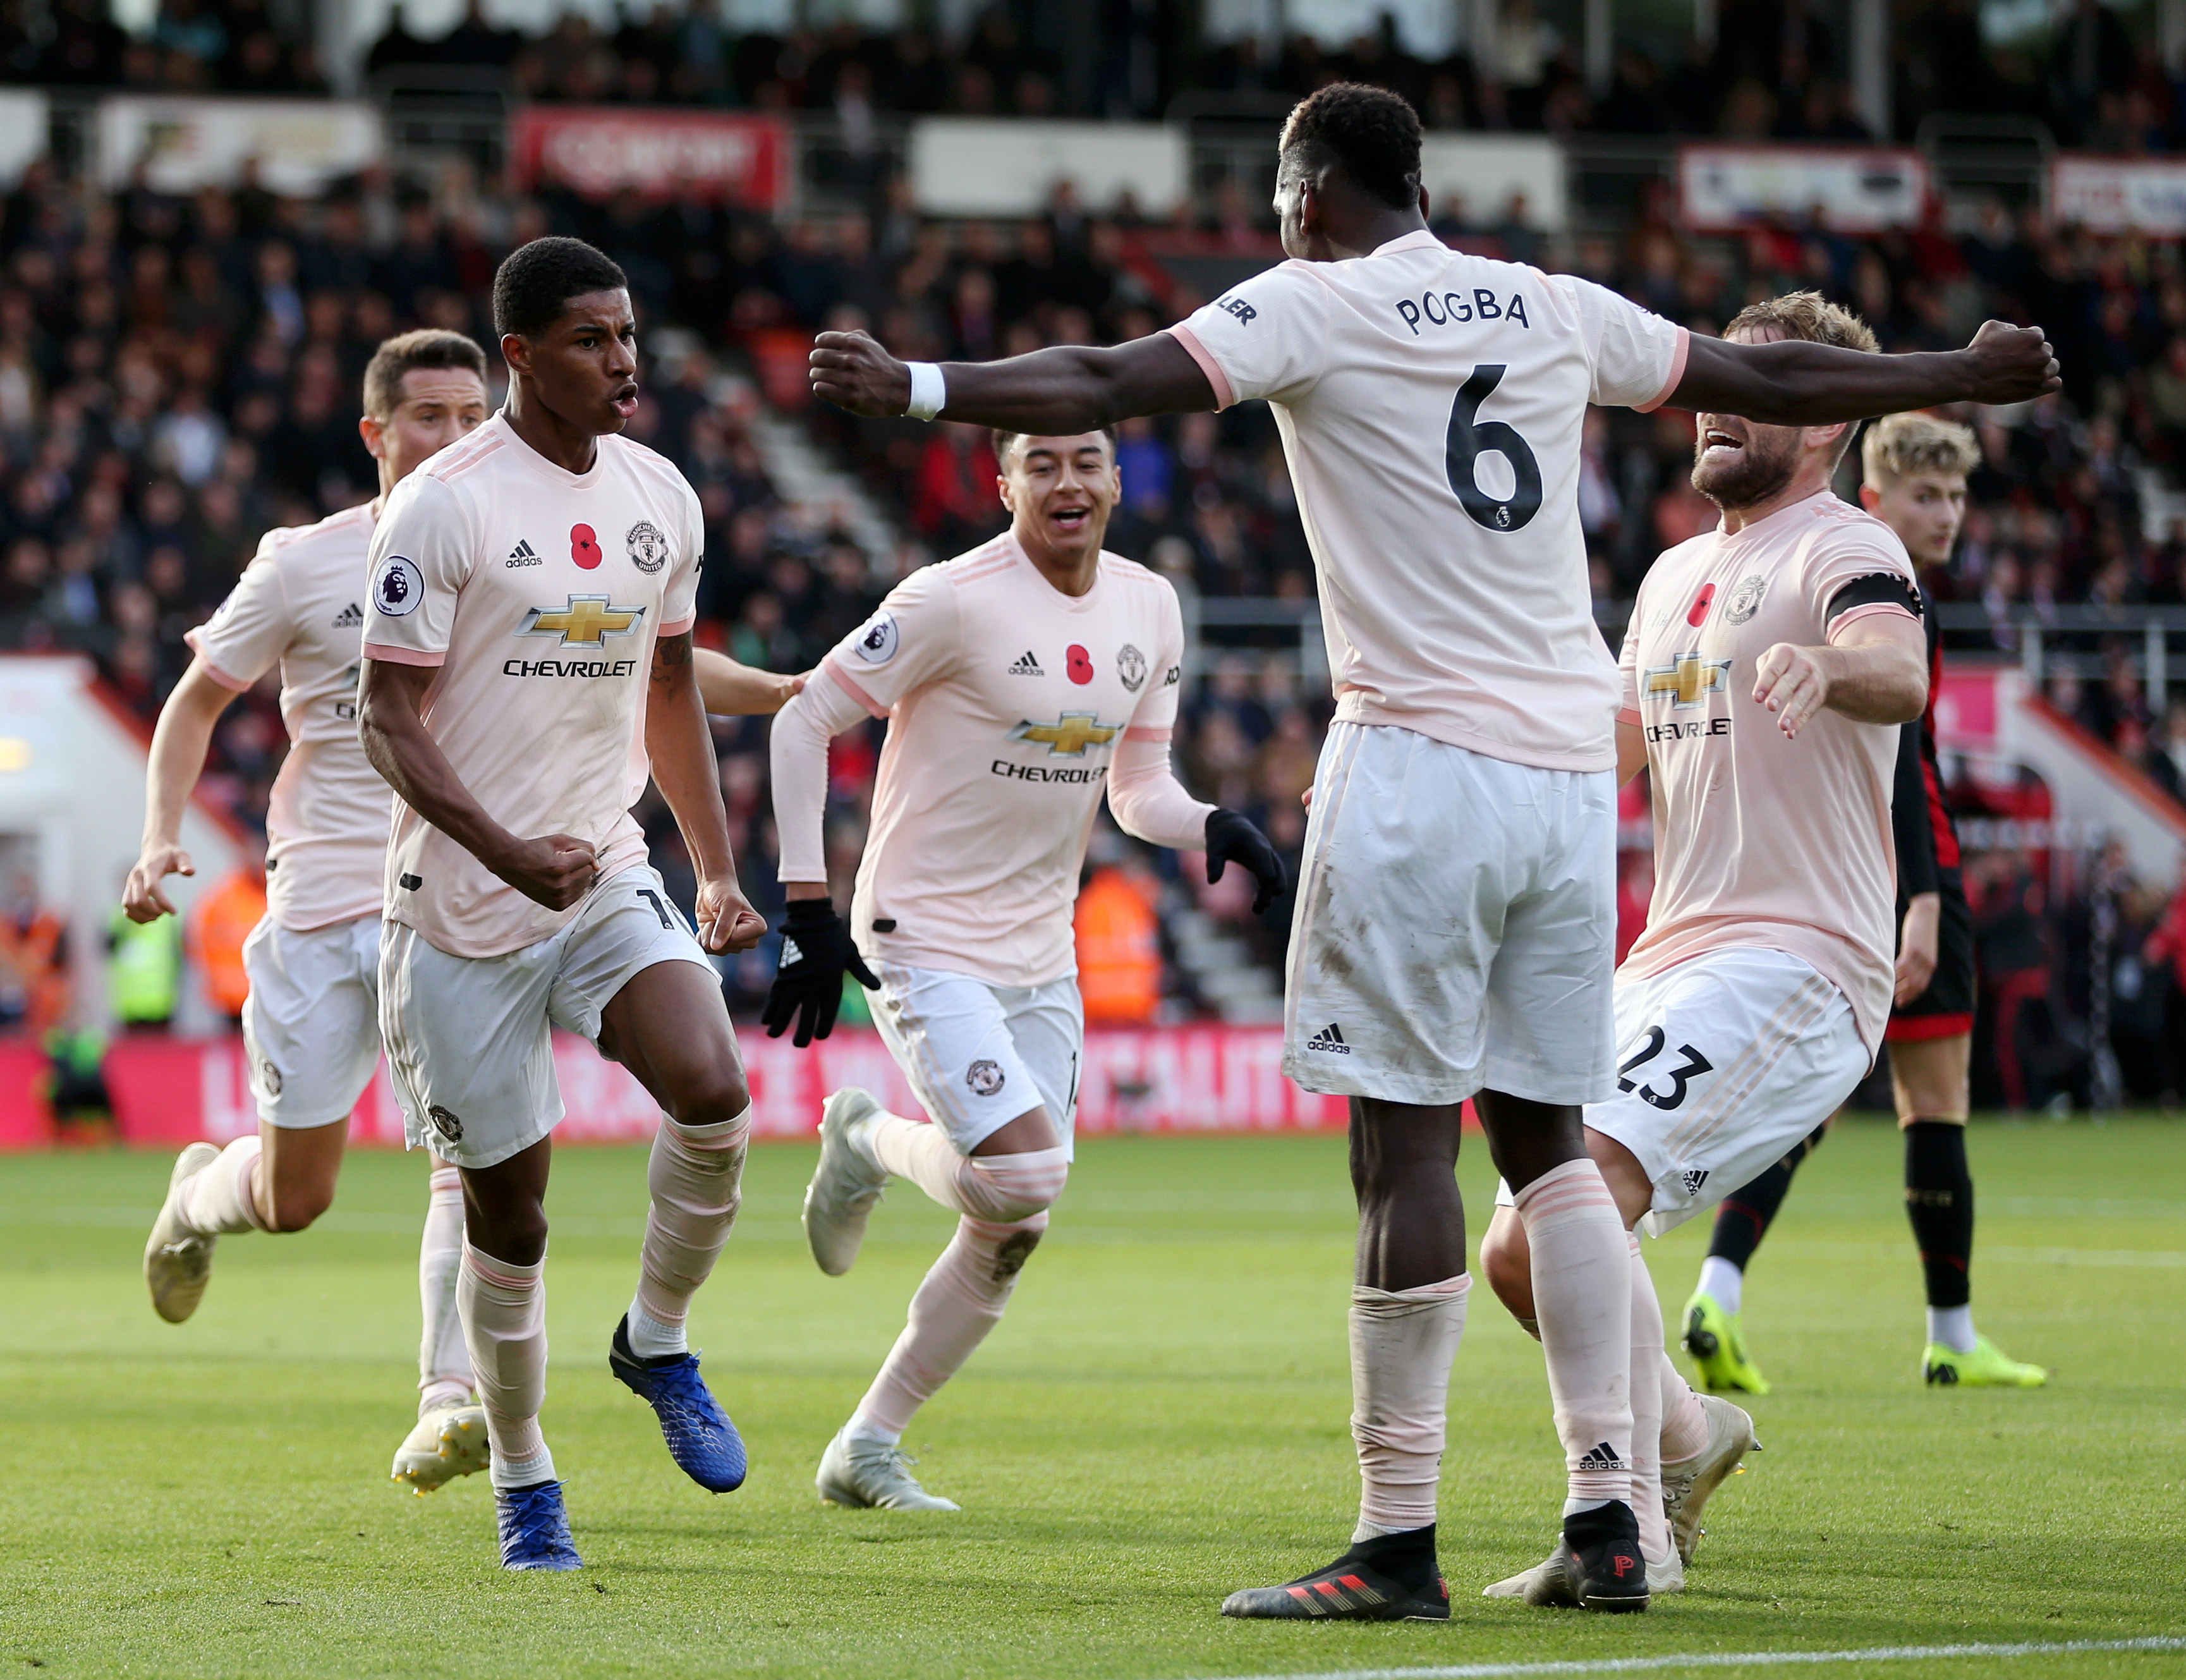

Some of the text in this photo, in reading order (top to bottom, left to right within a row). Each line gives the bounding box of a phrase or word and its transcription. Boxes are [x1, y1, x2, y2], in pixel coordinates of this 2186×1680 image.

[1216, 295, 1257, 327] LER
[1395, 288, 1530, 336] POGBA
[1444, 364, 1544, 533] 6
[506, 555, 543, 568] adidas
[638, 561, 662, 572] UNITED
[331, 619, 363, 629] adida
[503, 659, 636, 678] CHEVROLET
[1008, 666, 1044, 676] adidas
[991, 759, 1109, 784] CHEVROLET
[1307, 1040, 1351, 1055] adidas
[1617, 1025, 1714, 1111] 23
[1579, 1459, 1625, 1470] adidas
